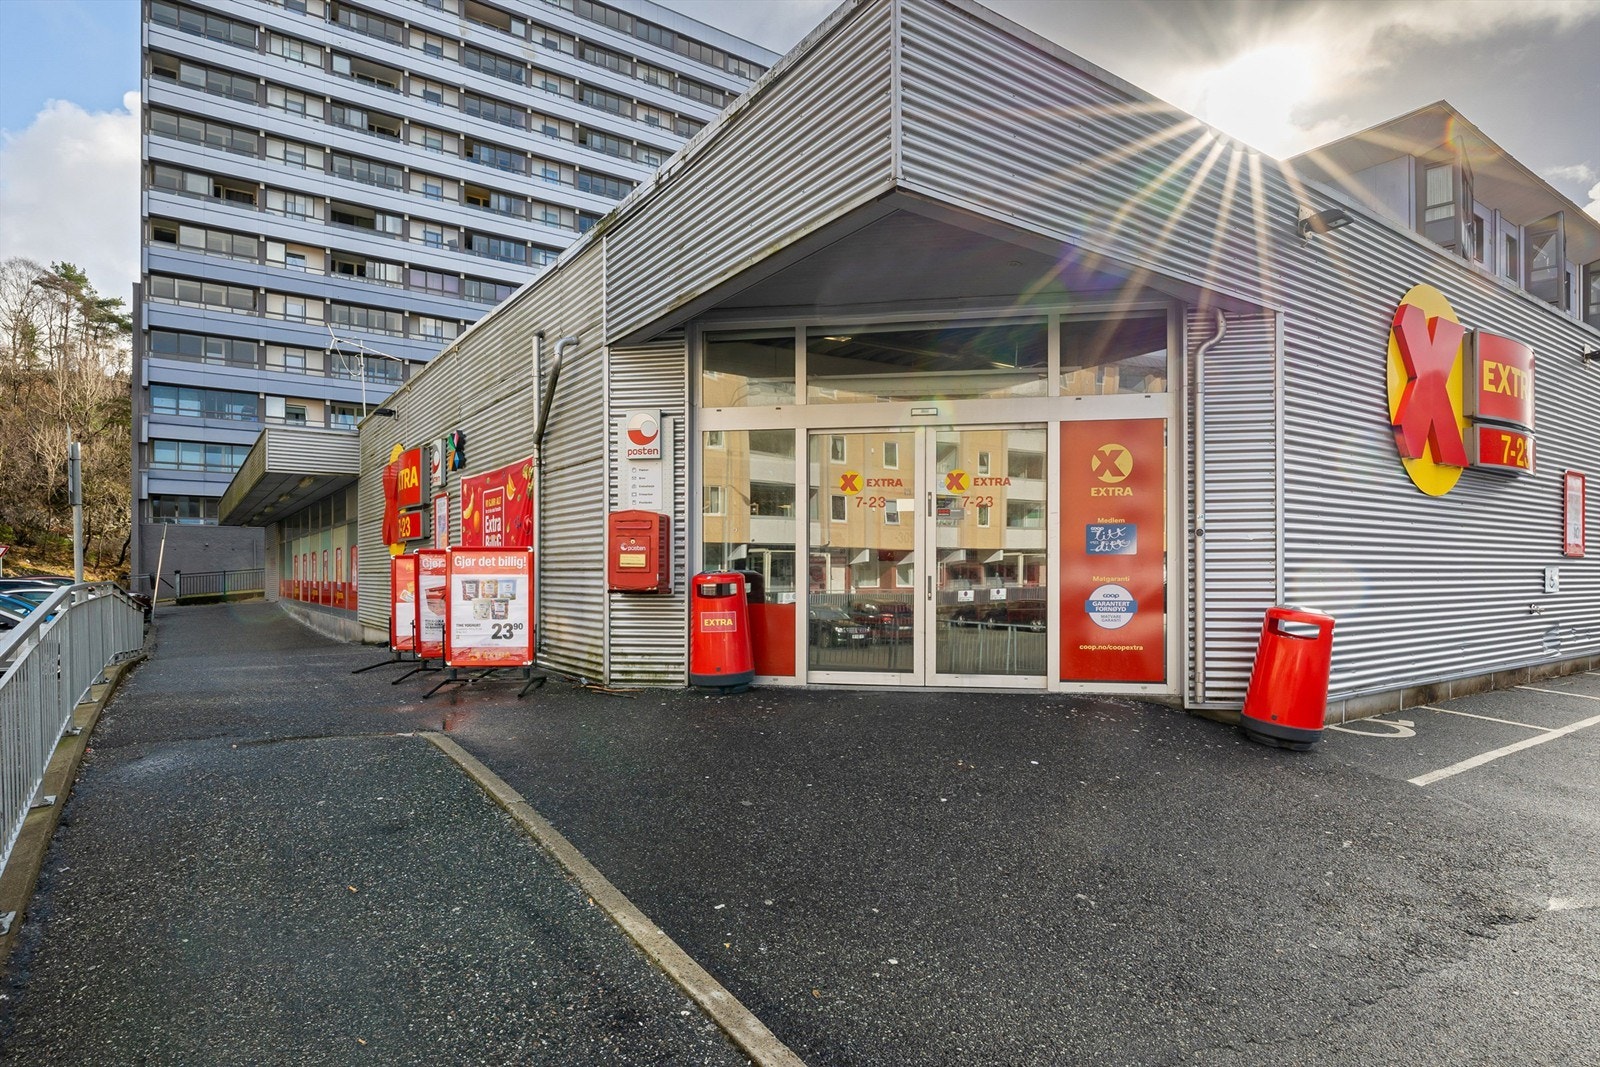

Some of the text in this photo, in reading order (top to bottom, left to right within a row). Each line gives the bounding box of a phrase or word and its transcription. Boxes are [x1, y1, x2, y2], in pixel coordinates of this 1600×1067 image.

[1483, 359, 1530, 400] EXTR
[627, 446, 659, 457] posten
[399, 466, 419, 491] TRA
[866, 478, 903, 487] EXTRA
[973, 477, 1011, 487] EXTRA
[1090, 486, 1134, 497] EXTRA
[856, 496, 886, 508] 7-23
[961, 495, 994, 508] 7-23
[485, 515, 502, 533] Extra
[454, 555, 527, 569] Gjør det billig!
[703, 618, 733, 626] EXTRA
[491, 622, 514, 640] 23
[1079, 644, 1144, 652] coop.no/coopextra
